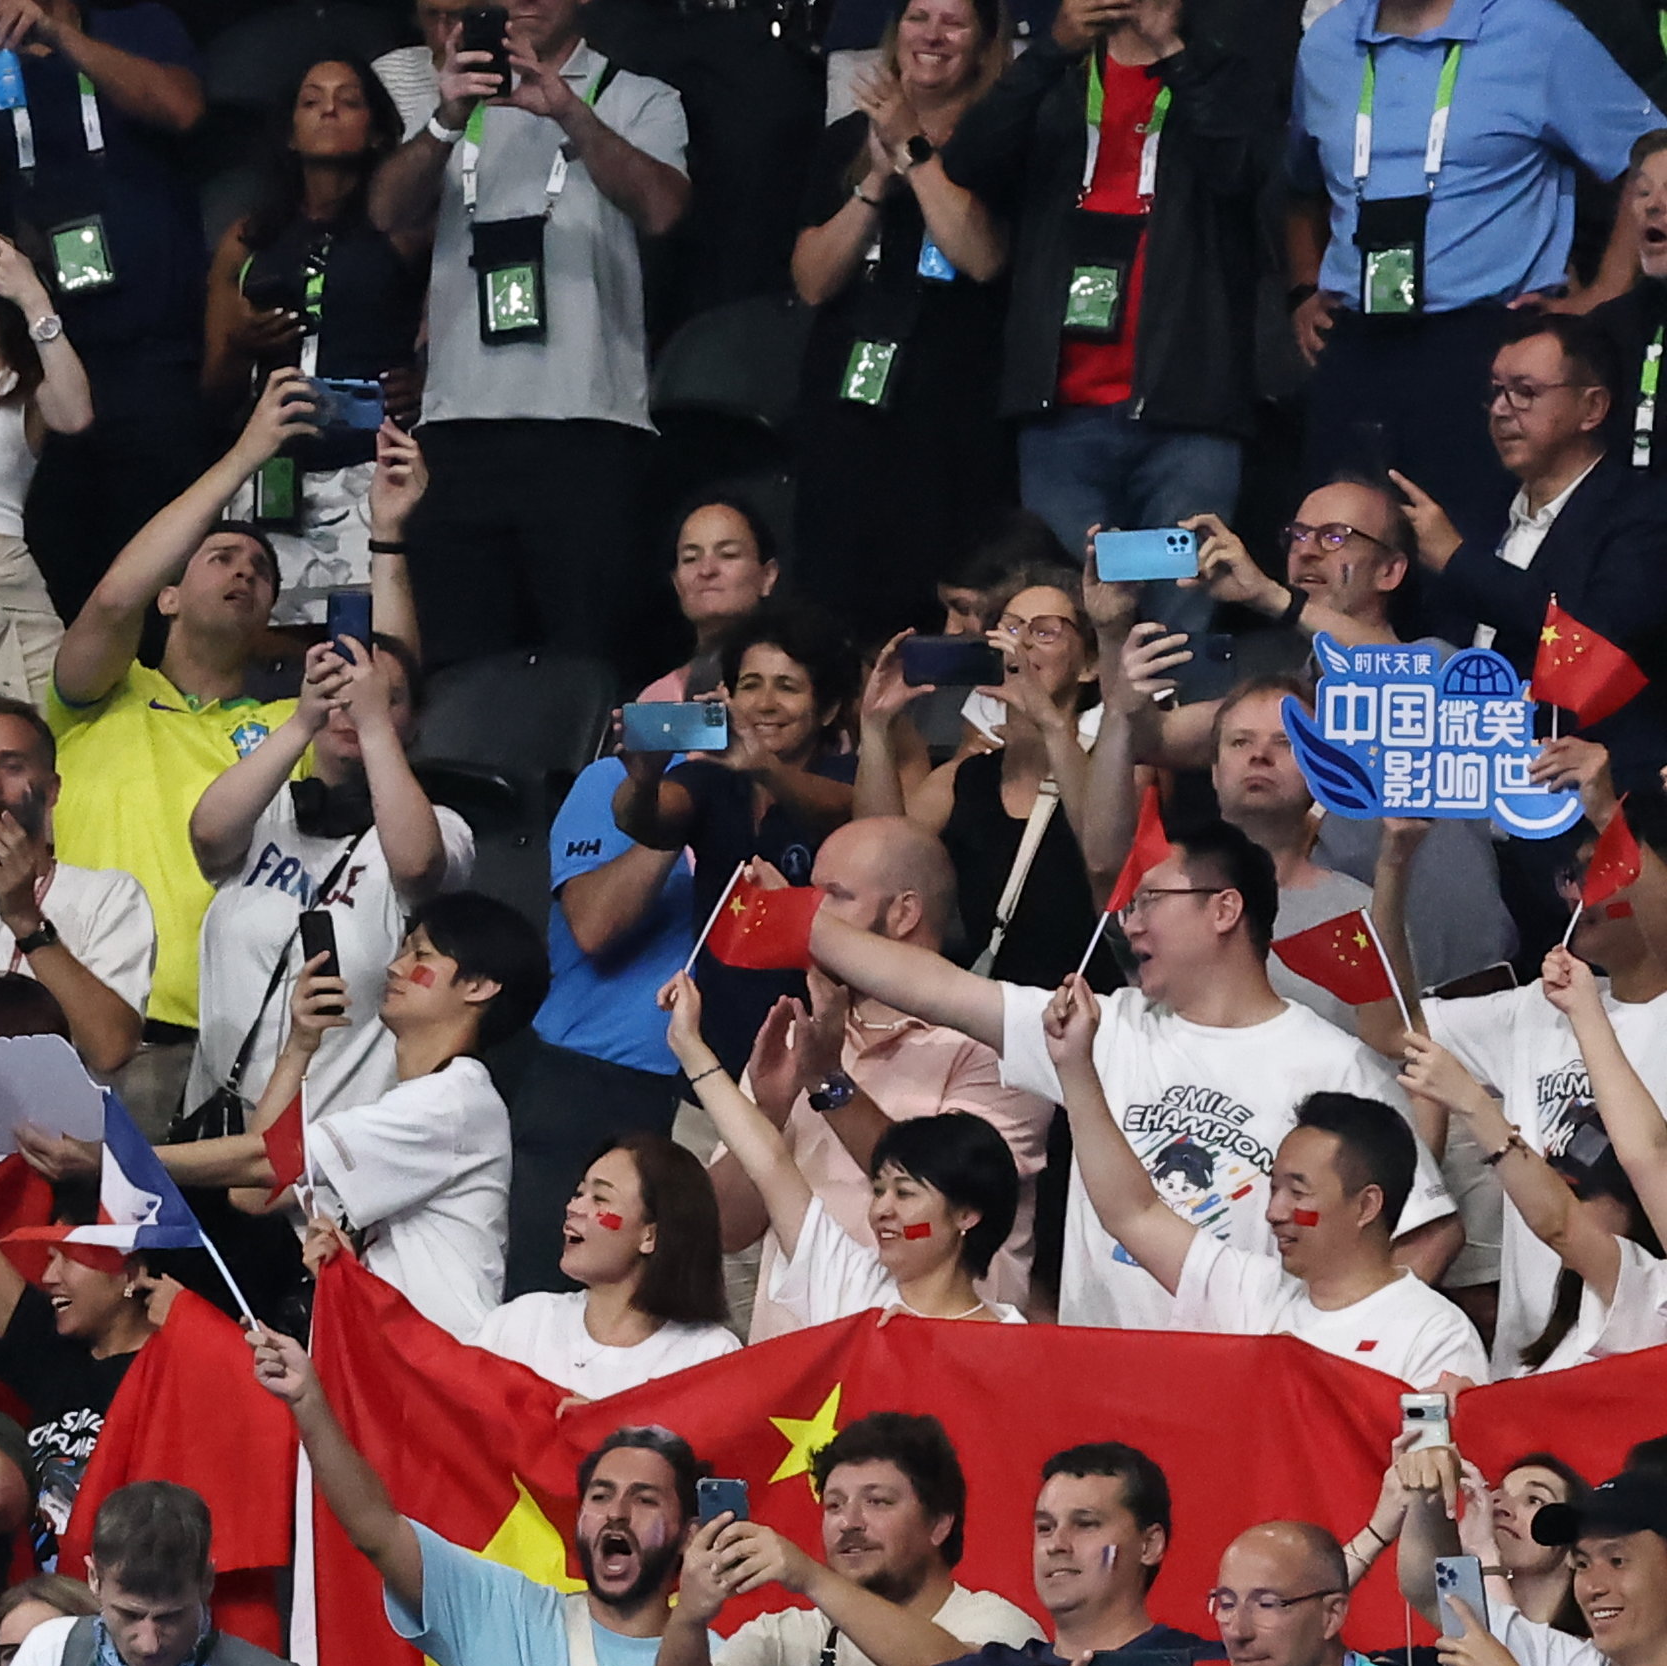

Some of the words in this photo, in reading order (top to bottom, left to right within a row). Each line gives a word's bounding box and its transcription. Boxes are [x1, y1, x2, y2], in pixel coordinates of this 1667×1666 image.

[1354, 652, 1433, 683] 时代天使
[1325, 681, 1525, 749] 中国微笑
[1383, 752, 1551, 811] 影响世
[1164, 1085, 1254, 1129] SMILE
[1123, 1104, 1274, 1176] CHAMPION
